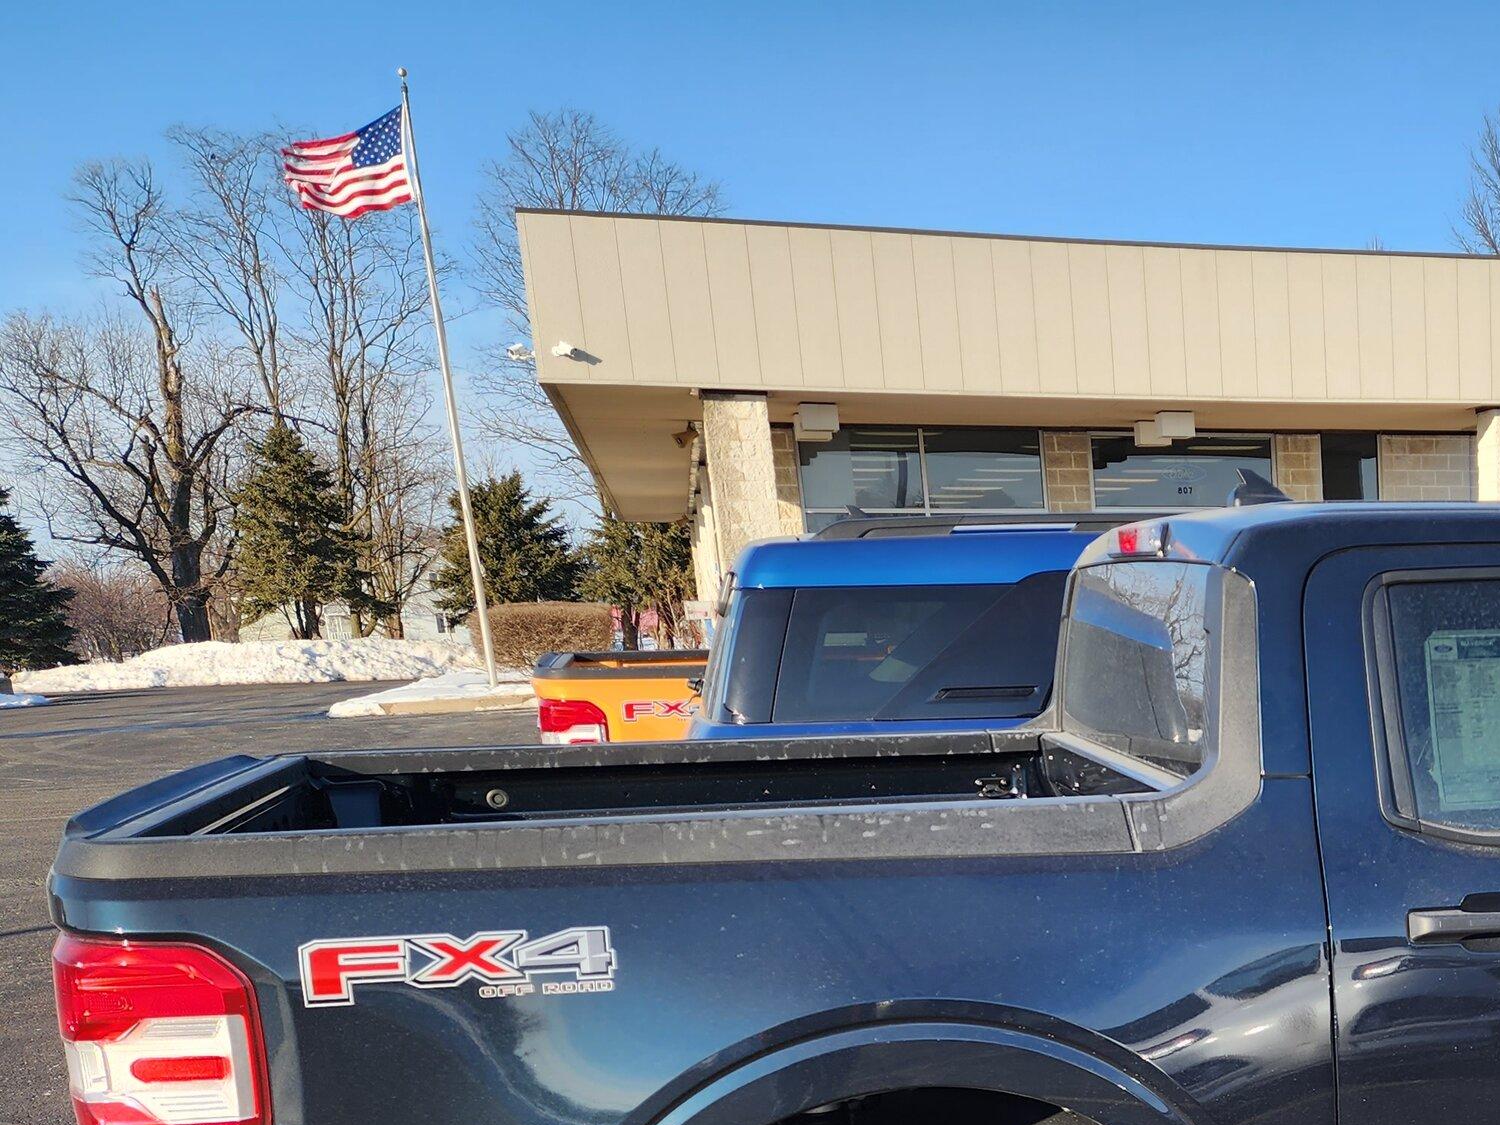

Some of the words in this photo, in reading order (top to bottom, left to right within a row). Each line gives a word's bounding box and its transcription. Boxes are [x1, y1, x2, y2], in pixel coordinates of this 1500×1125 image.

[1177, 486, 1193, 494] 807
[622, 700, 700, 723] FX
[298, 925, 618, 1008] FX4
[478, 985, 534, 999] OFF
[542, 979, 616, 995] ROAD
